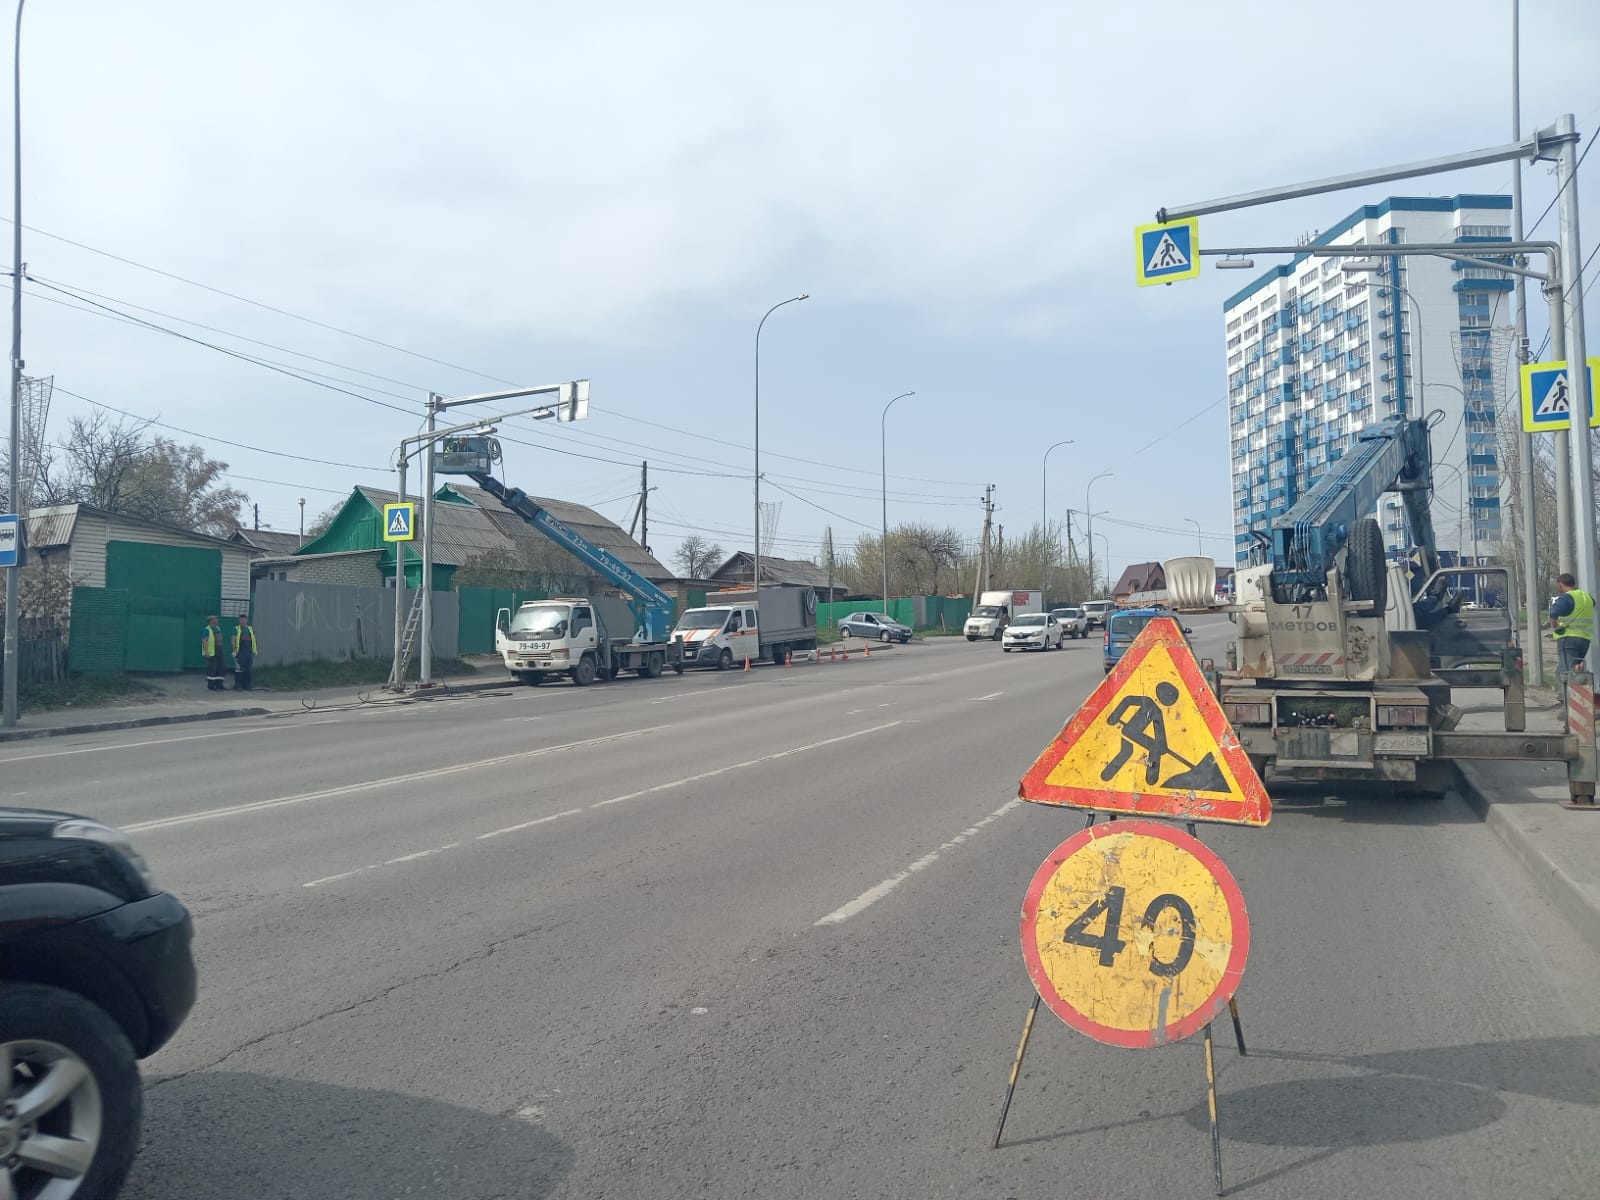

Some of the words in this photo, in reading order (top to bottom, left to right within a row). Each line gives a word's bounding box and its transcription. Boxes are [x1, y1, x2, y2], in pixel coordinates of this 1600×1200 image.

[1291, 605, 1313, 619] 17
[1271, 621, 1337, 633] метров
[519, 642, 551, 650] 79-49-97
[1062, 885, 1197, 978] 40
